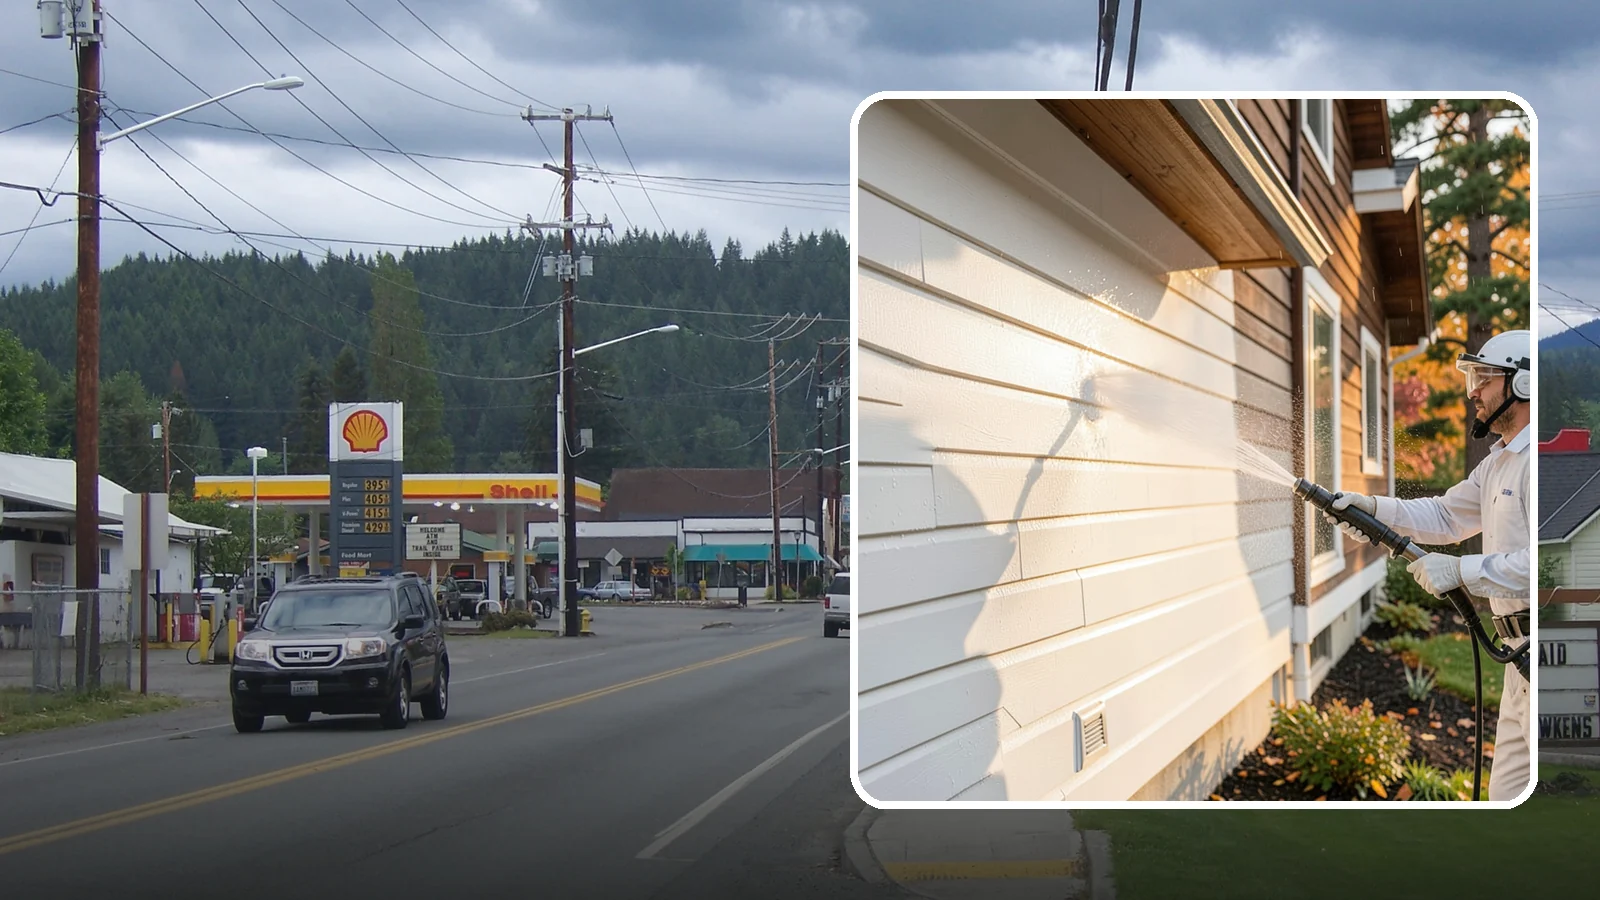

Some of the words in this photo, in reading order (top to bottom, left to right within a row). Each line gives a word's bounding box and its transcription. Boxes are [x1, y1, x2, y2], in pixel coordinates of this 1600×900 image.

[366, 480, 383, 490] 395
[490, 484, 547, 499] Shell
[365, 494, 383, 504] 405
[365, 508, 383, 518] 415
[365, 522, 383, 533] 429
